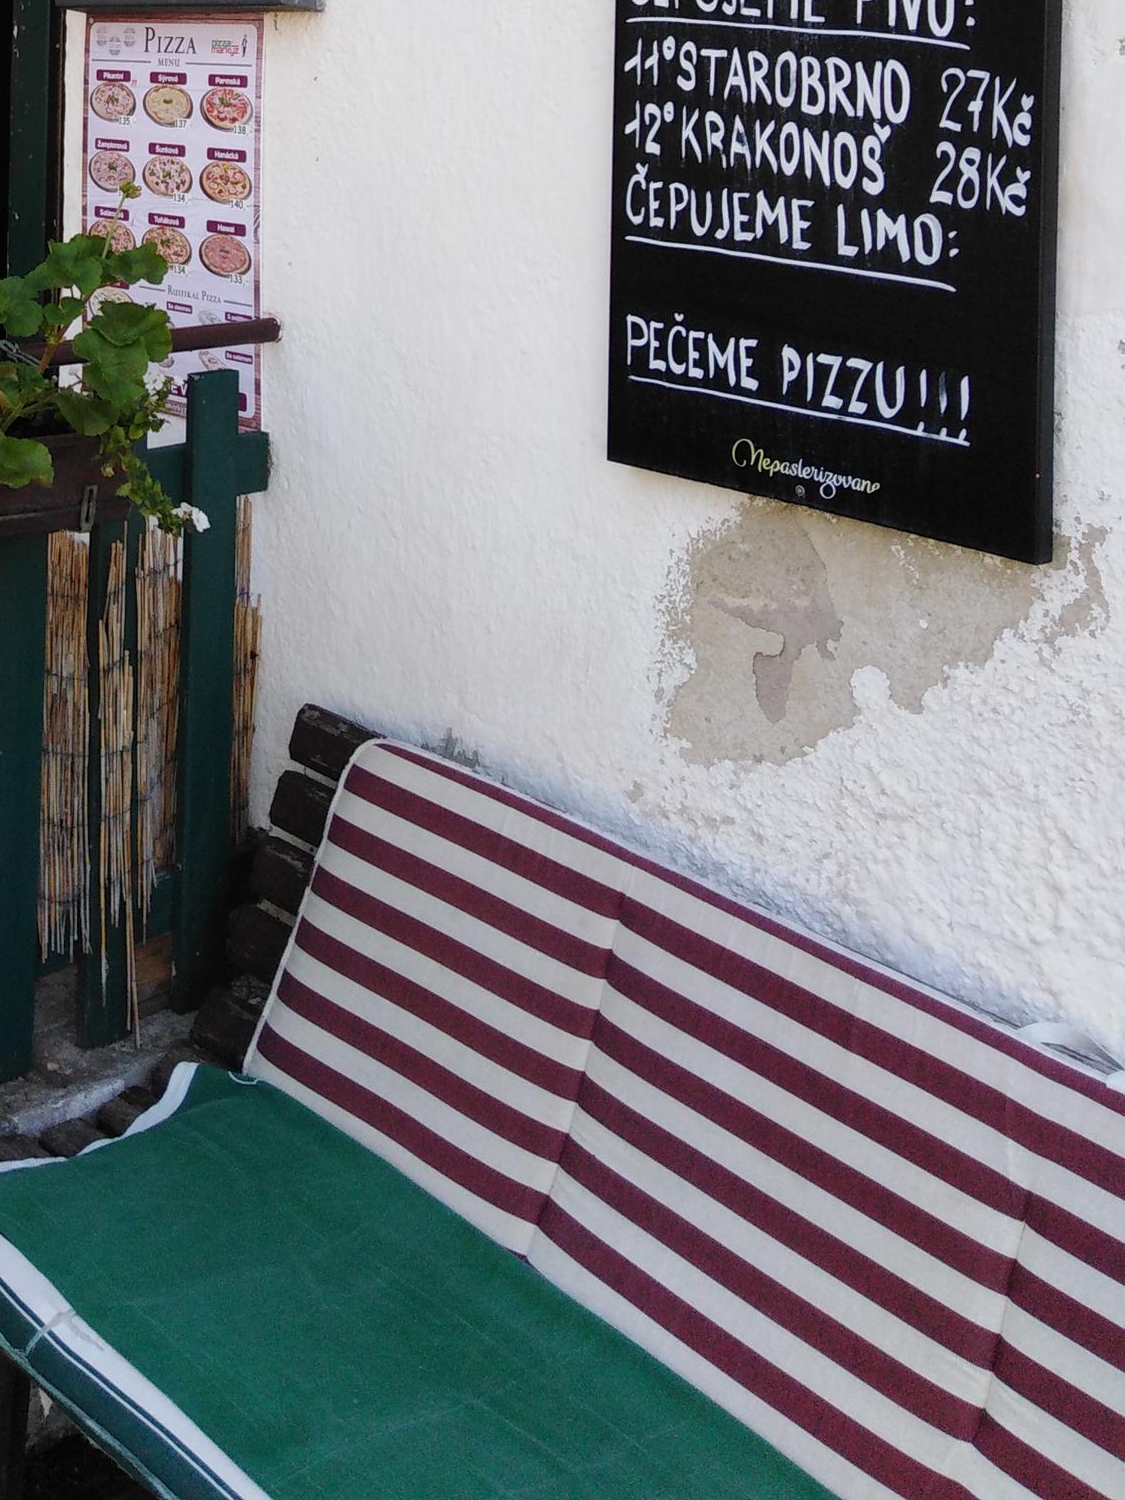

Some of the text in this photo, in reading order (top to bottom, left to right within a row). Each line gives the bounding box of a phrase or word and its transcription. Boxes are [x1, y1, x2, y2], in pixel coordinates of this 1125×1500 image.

[158, 58, 181, 67] MENU
[680, 105, 891, 196] KRAKONOŠ
[625, 162, 960, 266] ČEPUJEME LIMO:
[626, 313, 759, 391] PEČEME
